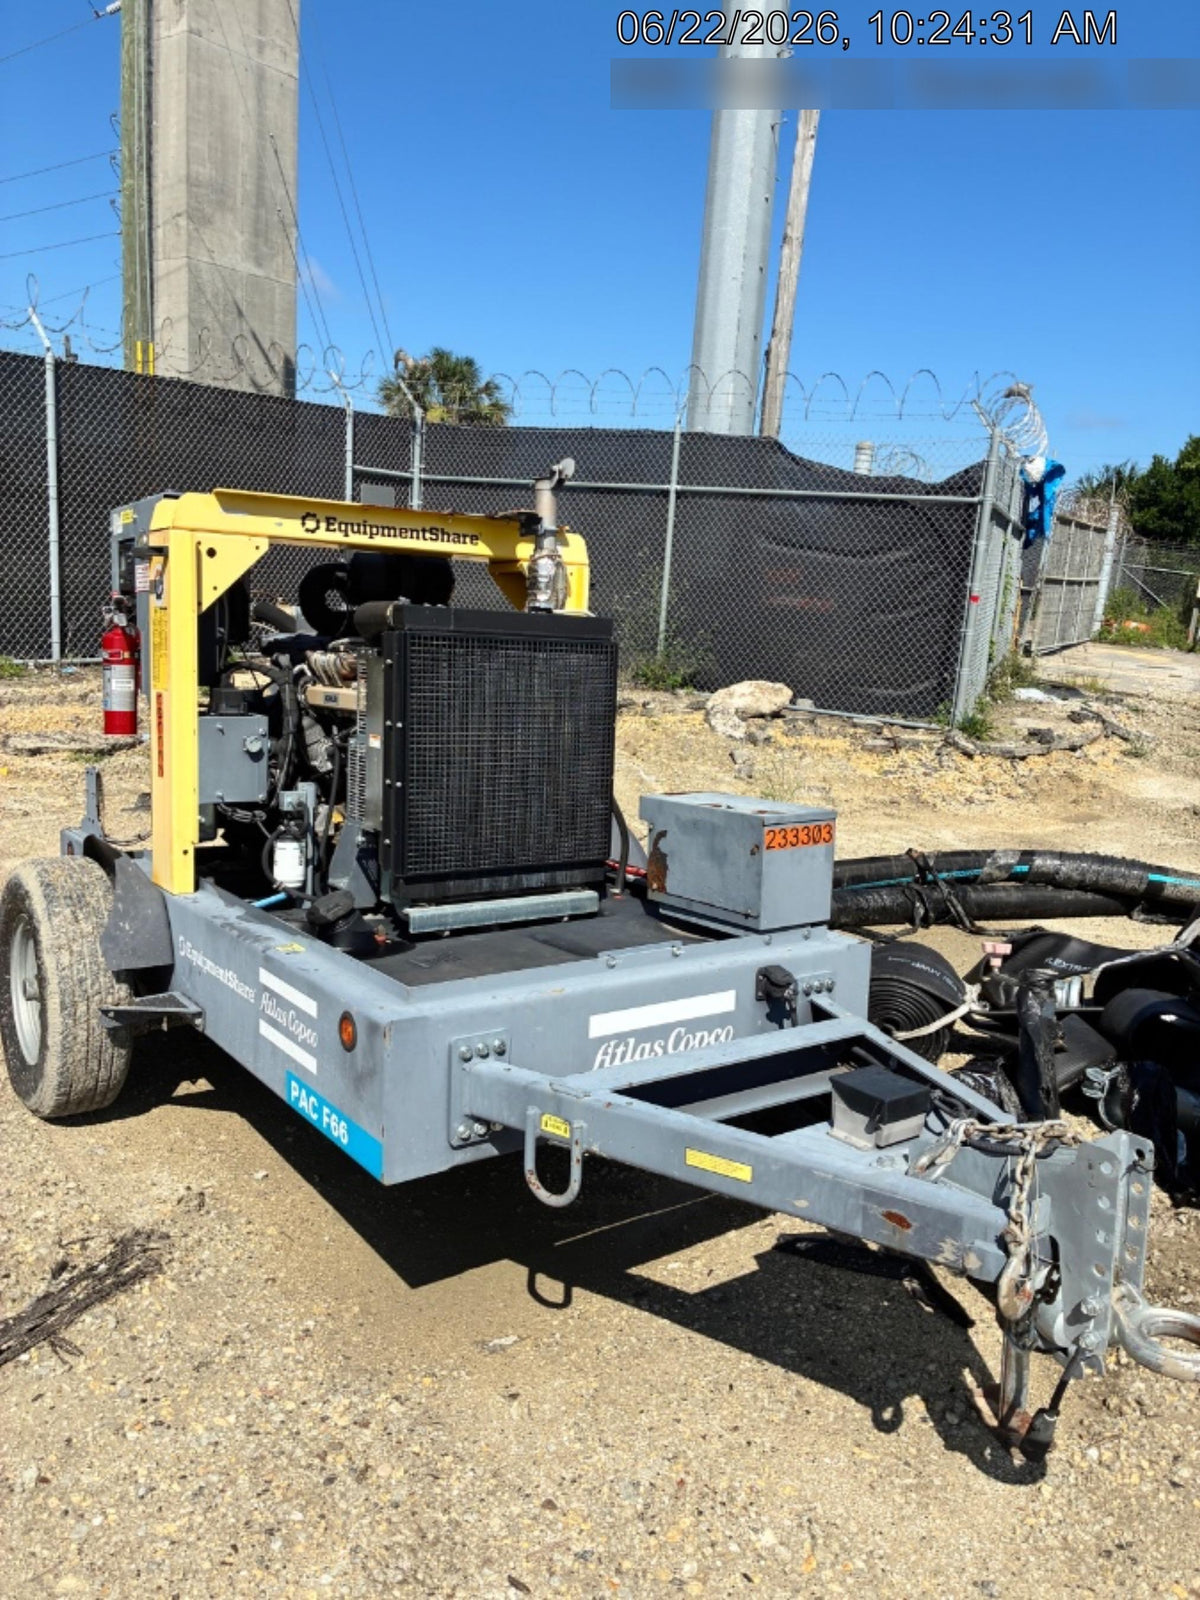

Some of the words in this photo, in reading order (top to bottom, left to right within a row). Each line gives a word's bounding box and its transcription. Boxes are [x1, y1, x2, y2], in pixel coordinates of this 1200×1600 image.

[324, 516, 480, 546] EquipmentShare
[766, 823, 834, 850] 233303
[186, 941, 256, 1004] EquipmentShare
[260, 992, 287, 1027] Atlas
[287, 1010, 318, 1048] Copco
[592, 1037, 664, 1071] Atlas
[290, 1080, 318, 1119] PAC
[322, 1107, 349, 1145] F66
